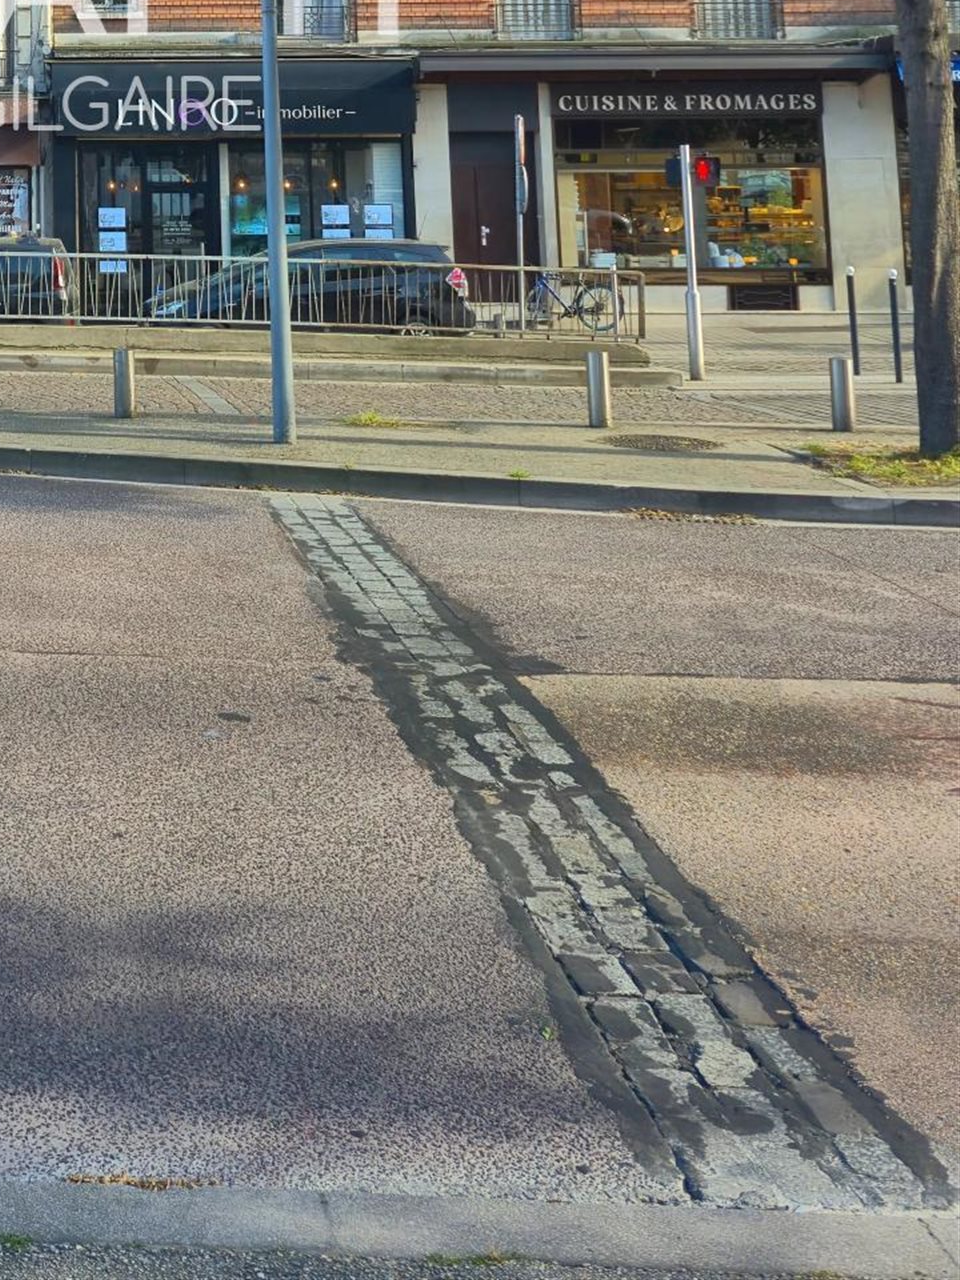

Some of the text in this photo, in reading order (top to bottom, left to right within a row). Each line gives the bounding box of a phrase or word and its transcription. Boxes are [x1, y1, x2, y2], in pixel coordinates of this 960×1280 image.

[558, 93, 817, 112] CUISINE & FROMAGES
